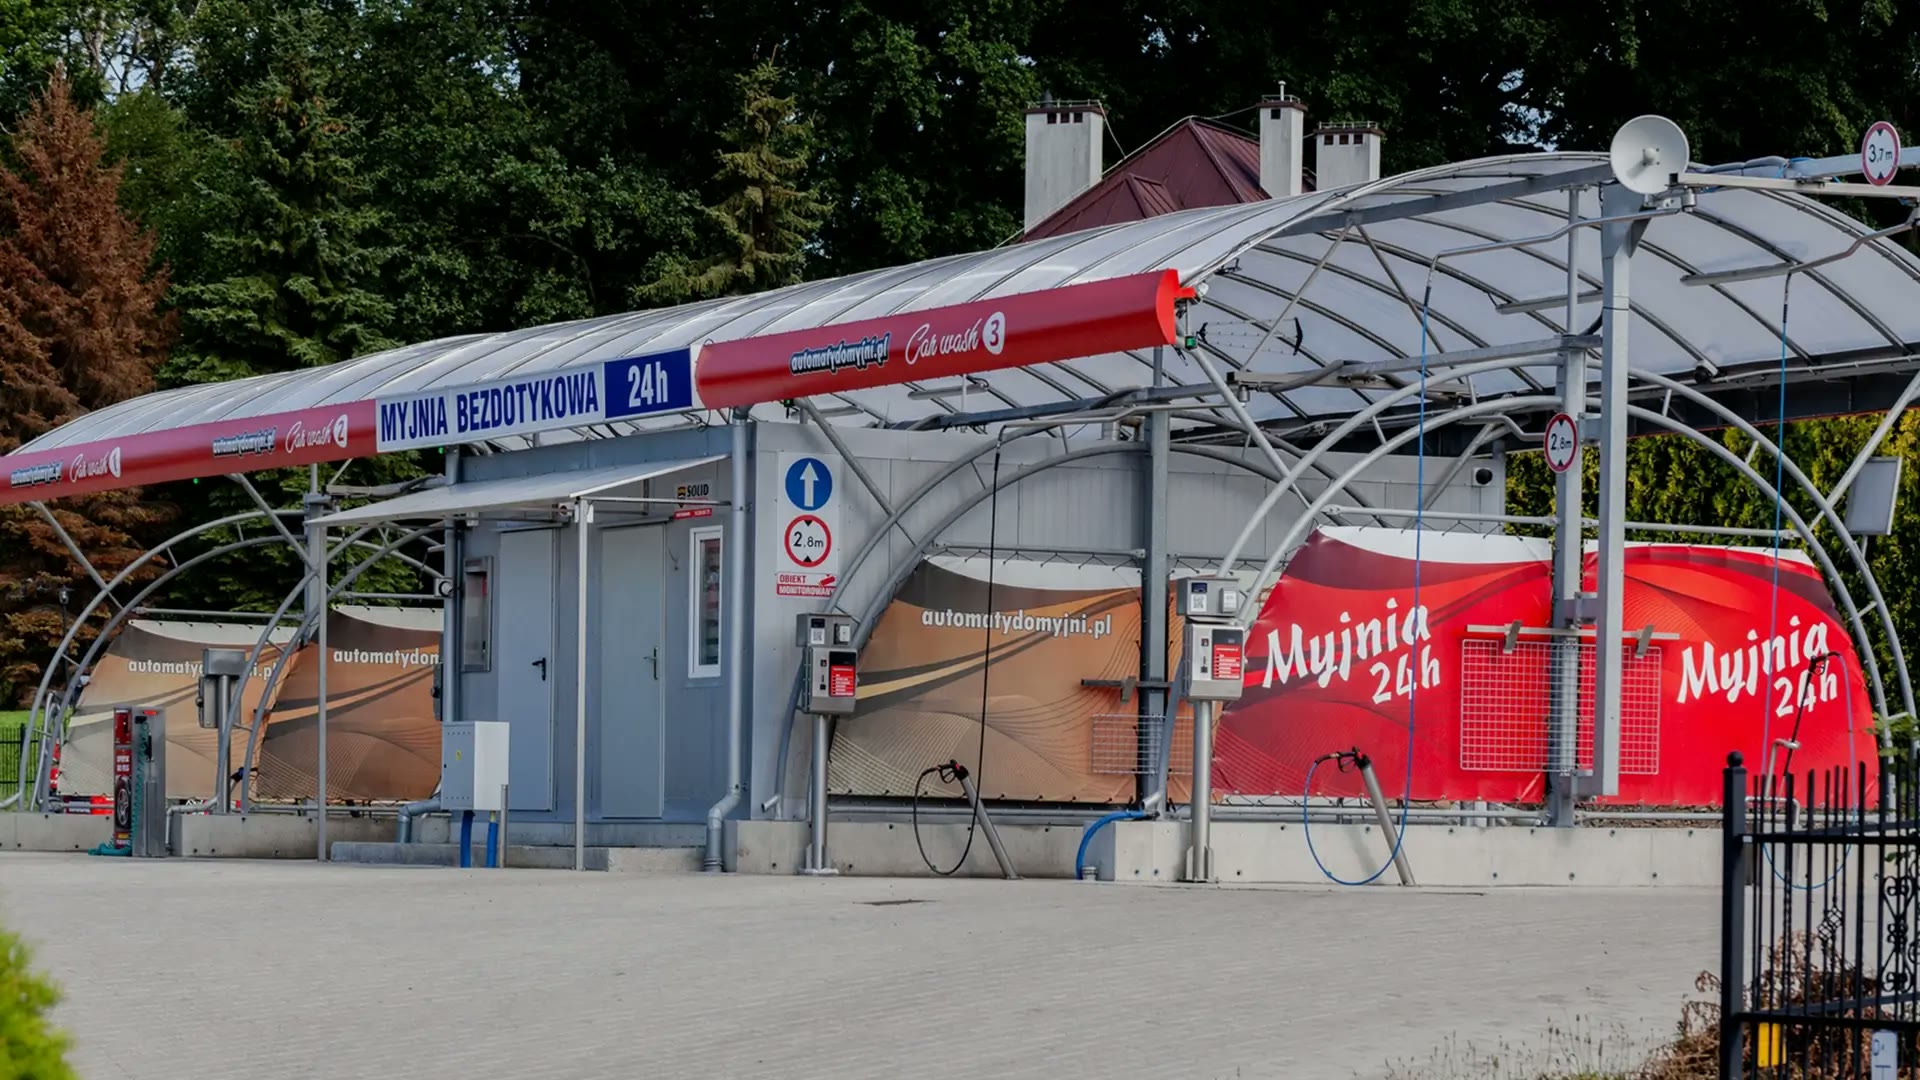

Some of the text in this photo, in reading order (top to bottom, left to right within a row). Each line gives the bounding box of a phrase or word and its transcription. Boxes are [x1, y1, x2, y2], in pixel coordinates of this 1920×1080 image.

[790, 318, 1000, 374] automatydomyjni.pl Car wash 3
[380, 360, 669, 442] MYJNIA BEZDOTYKOWA 24h
[687, 483, 709, 498] SOLID
[779, 574, 806, 584] OBIEKT
[921, 608, 1112, 639] automatydomyjni.pl
[1262, 597, 1431, 689] Myjnia
[1369, 644, 1441, 705] 24h
[1676, 615, 1831, 704] Myjnia
[1773, 658, 1838, 718] 24h
